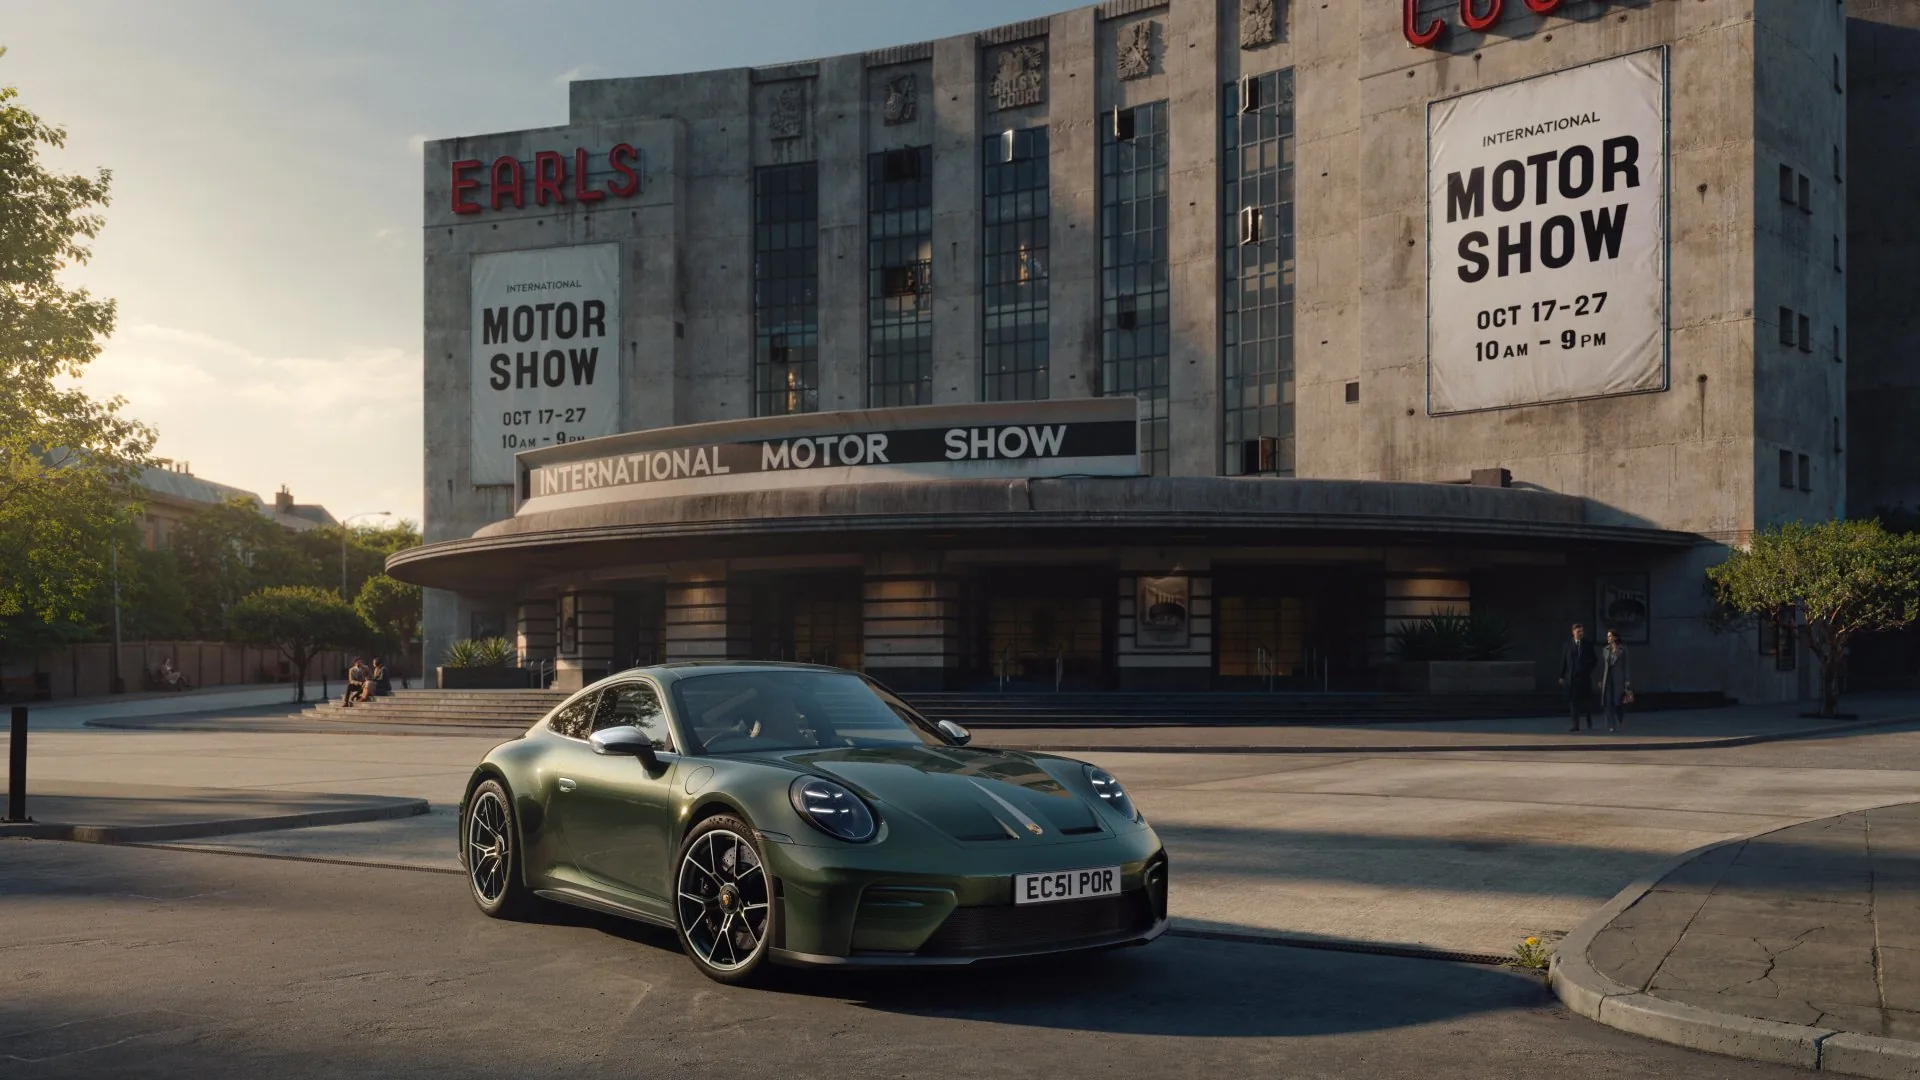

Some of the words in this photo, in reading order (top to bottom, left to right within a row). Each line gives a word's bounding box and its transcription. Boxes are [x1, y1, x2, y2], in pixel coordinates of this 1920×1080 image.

[1482, 111, 1601, 147] INTERNATIONAL
[451, 143, 639, 215] EARLS
[1446, 135, 1640, 223] MOTOR
[1457, 203, 1629, 283] SHOW
[506, 279, 582, 294] INTERNATIONAL
[483, 299, 606, 345] MOTOR
[1476, 305, 1521, 330] OCT
[1531, 292, 1608, 323] 17-27
[489, 347, 599, 391] SHOW
[502, 410, 532, 426] OCT
[538, 407, 586, 425] 17-27
[539, 445, 730, 495] INTERNATIONAL
[761, 433, 889, 469] MOTOR
[944, 424, 1068, 461] SHOW
[1079, 869, 1113, 895] POR
